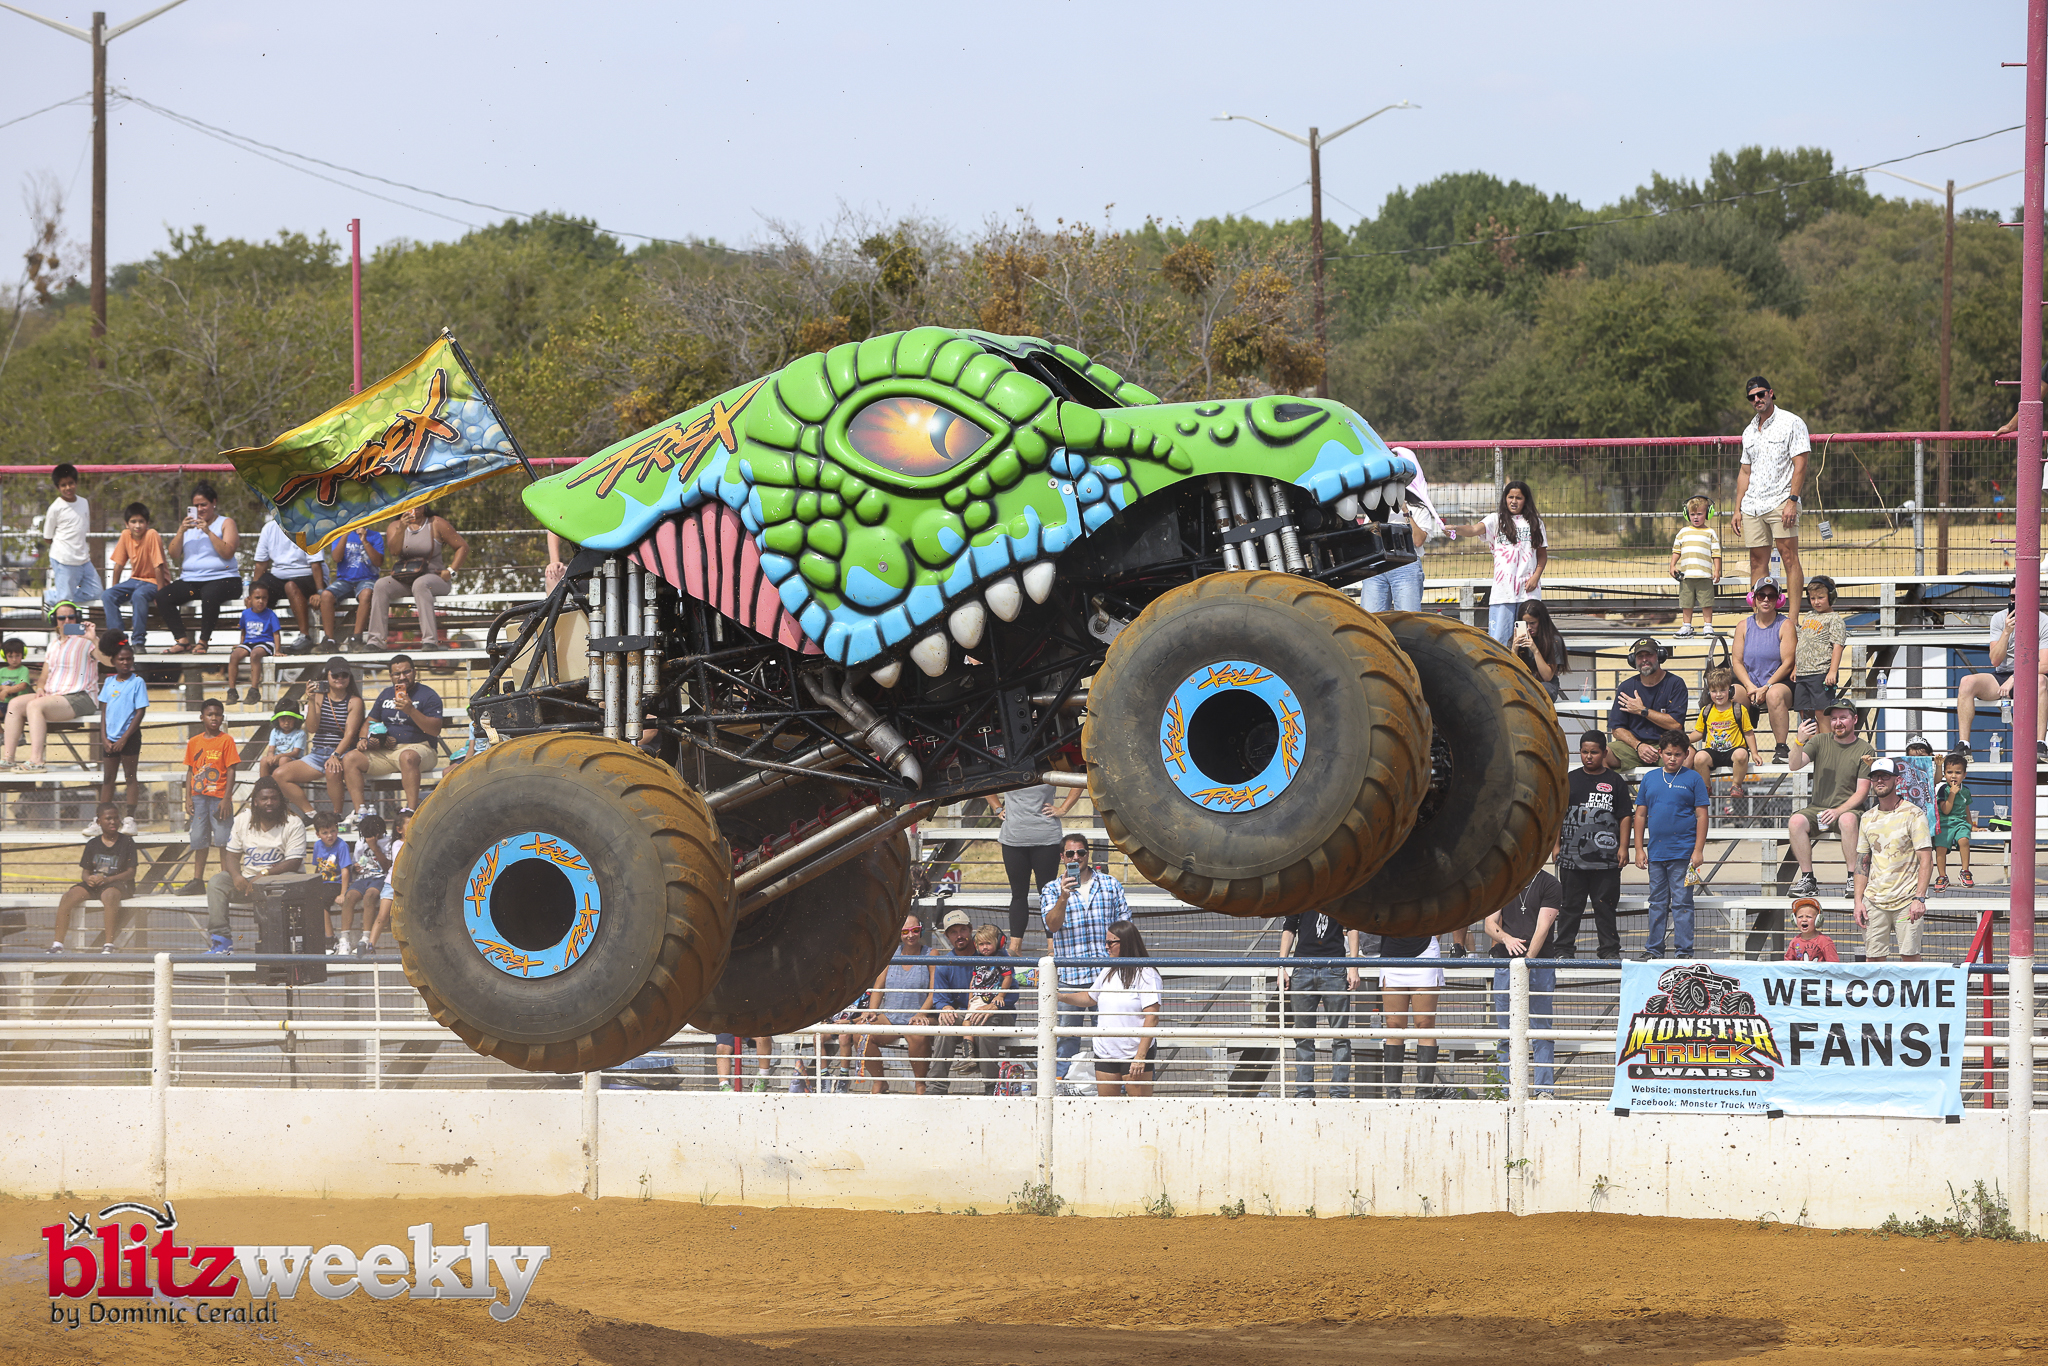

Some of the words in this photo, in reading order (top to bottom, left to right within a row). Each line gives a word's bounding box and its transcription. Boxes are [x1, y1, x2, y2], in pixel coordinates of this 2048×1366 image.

[1763, 978, 1956, 1008] WELCOME
[1624, 1016, 1780, 1060] MONSTER
[1789, 1022, 1950, 1067] FANS!
[1642, 1043, 1757, 1065] TRUCK
[1650, 1067, 1751, 1078] WARS
[1631, 1085, 1671, 1094] Website:
[1673, 1087, 1757, 1097] monstertrucks.fun
[1631, 1098, 1677, 1107] Facebook:
[1680, 1099, 1718, 1108] Monster
[1720, 1100, 1745, 1109] Truck
[1748, 1102, 1771, 1110] Wars
